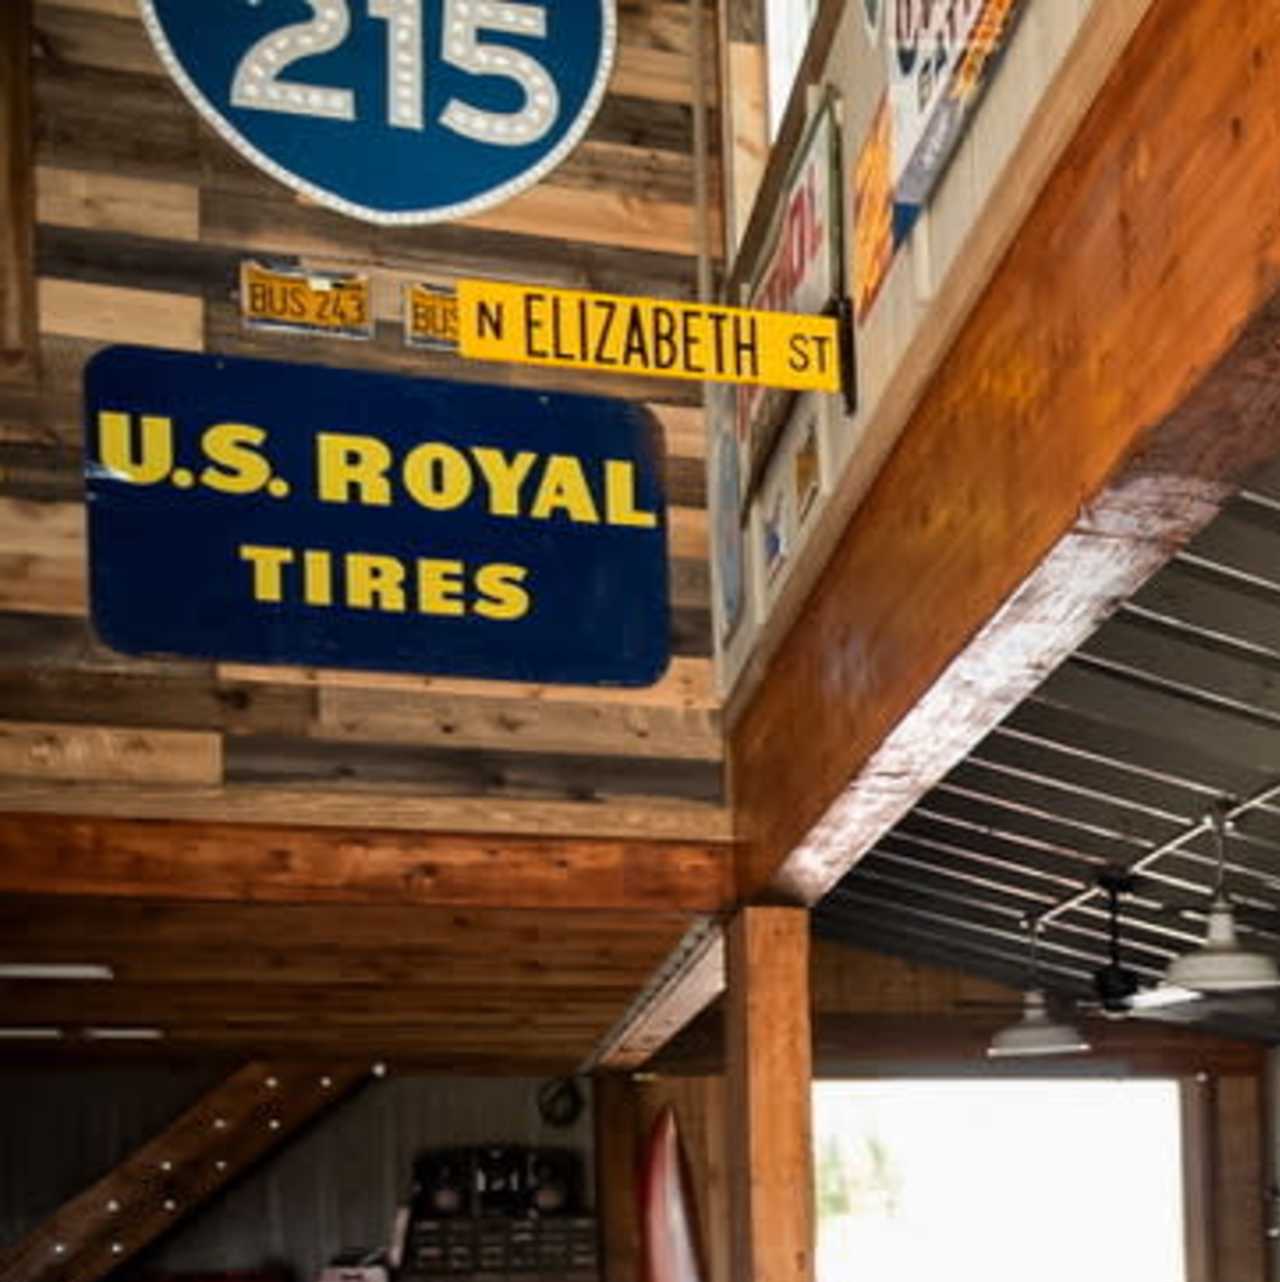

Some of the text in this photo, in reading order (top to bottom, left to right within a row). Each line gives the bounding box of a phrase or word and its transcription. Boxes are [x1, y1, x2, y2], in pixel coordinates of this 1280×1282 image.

[230, 0, 560, 146] 215
[251, 281, 366, 324] BUS 243
[477, 293, 830, 377] N ELIZABETH ST
[97, 410, 658, 528] U.S. ROYAL
[239, 545, 530, 621] TIRES
